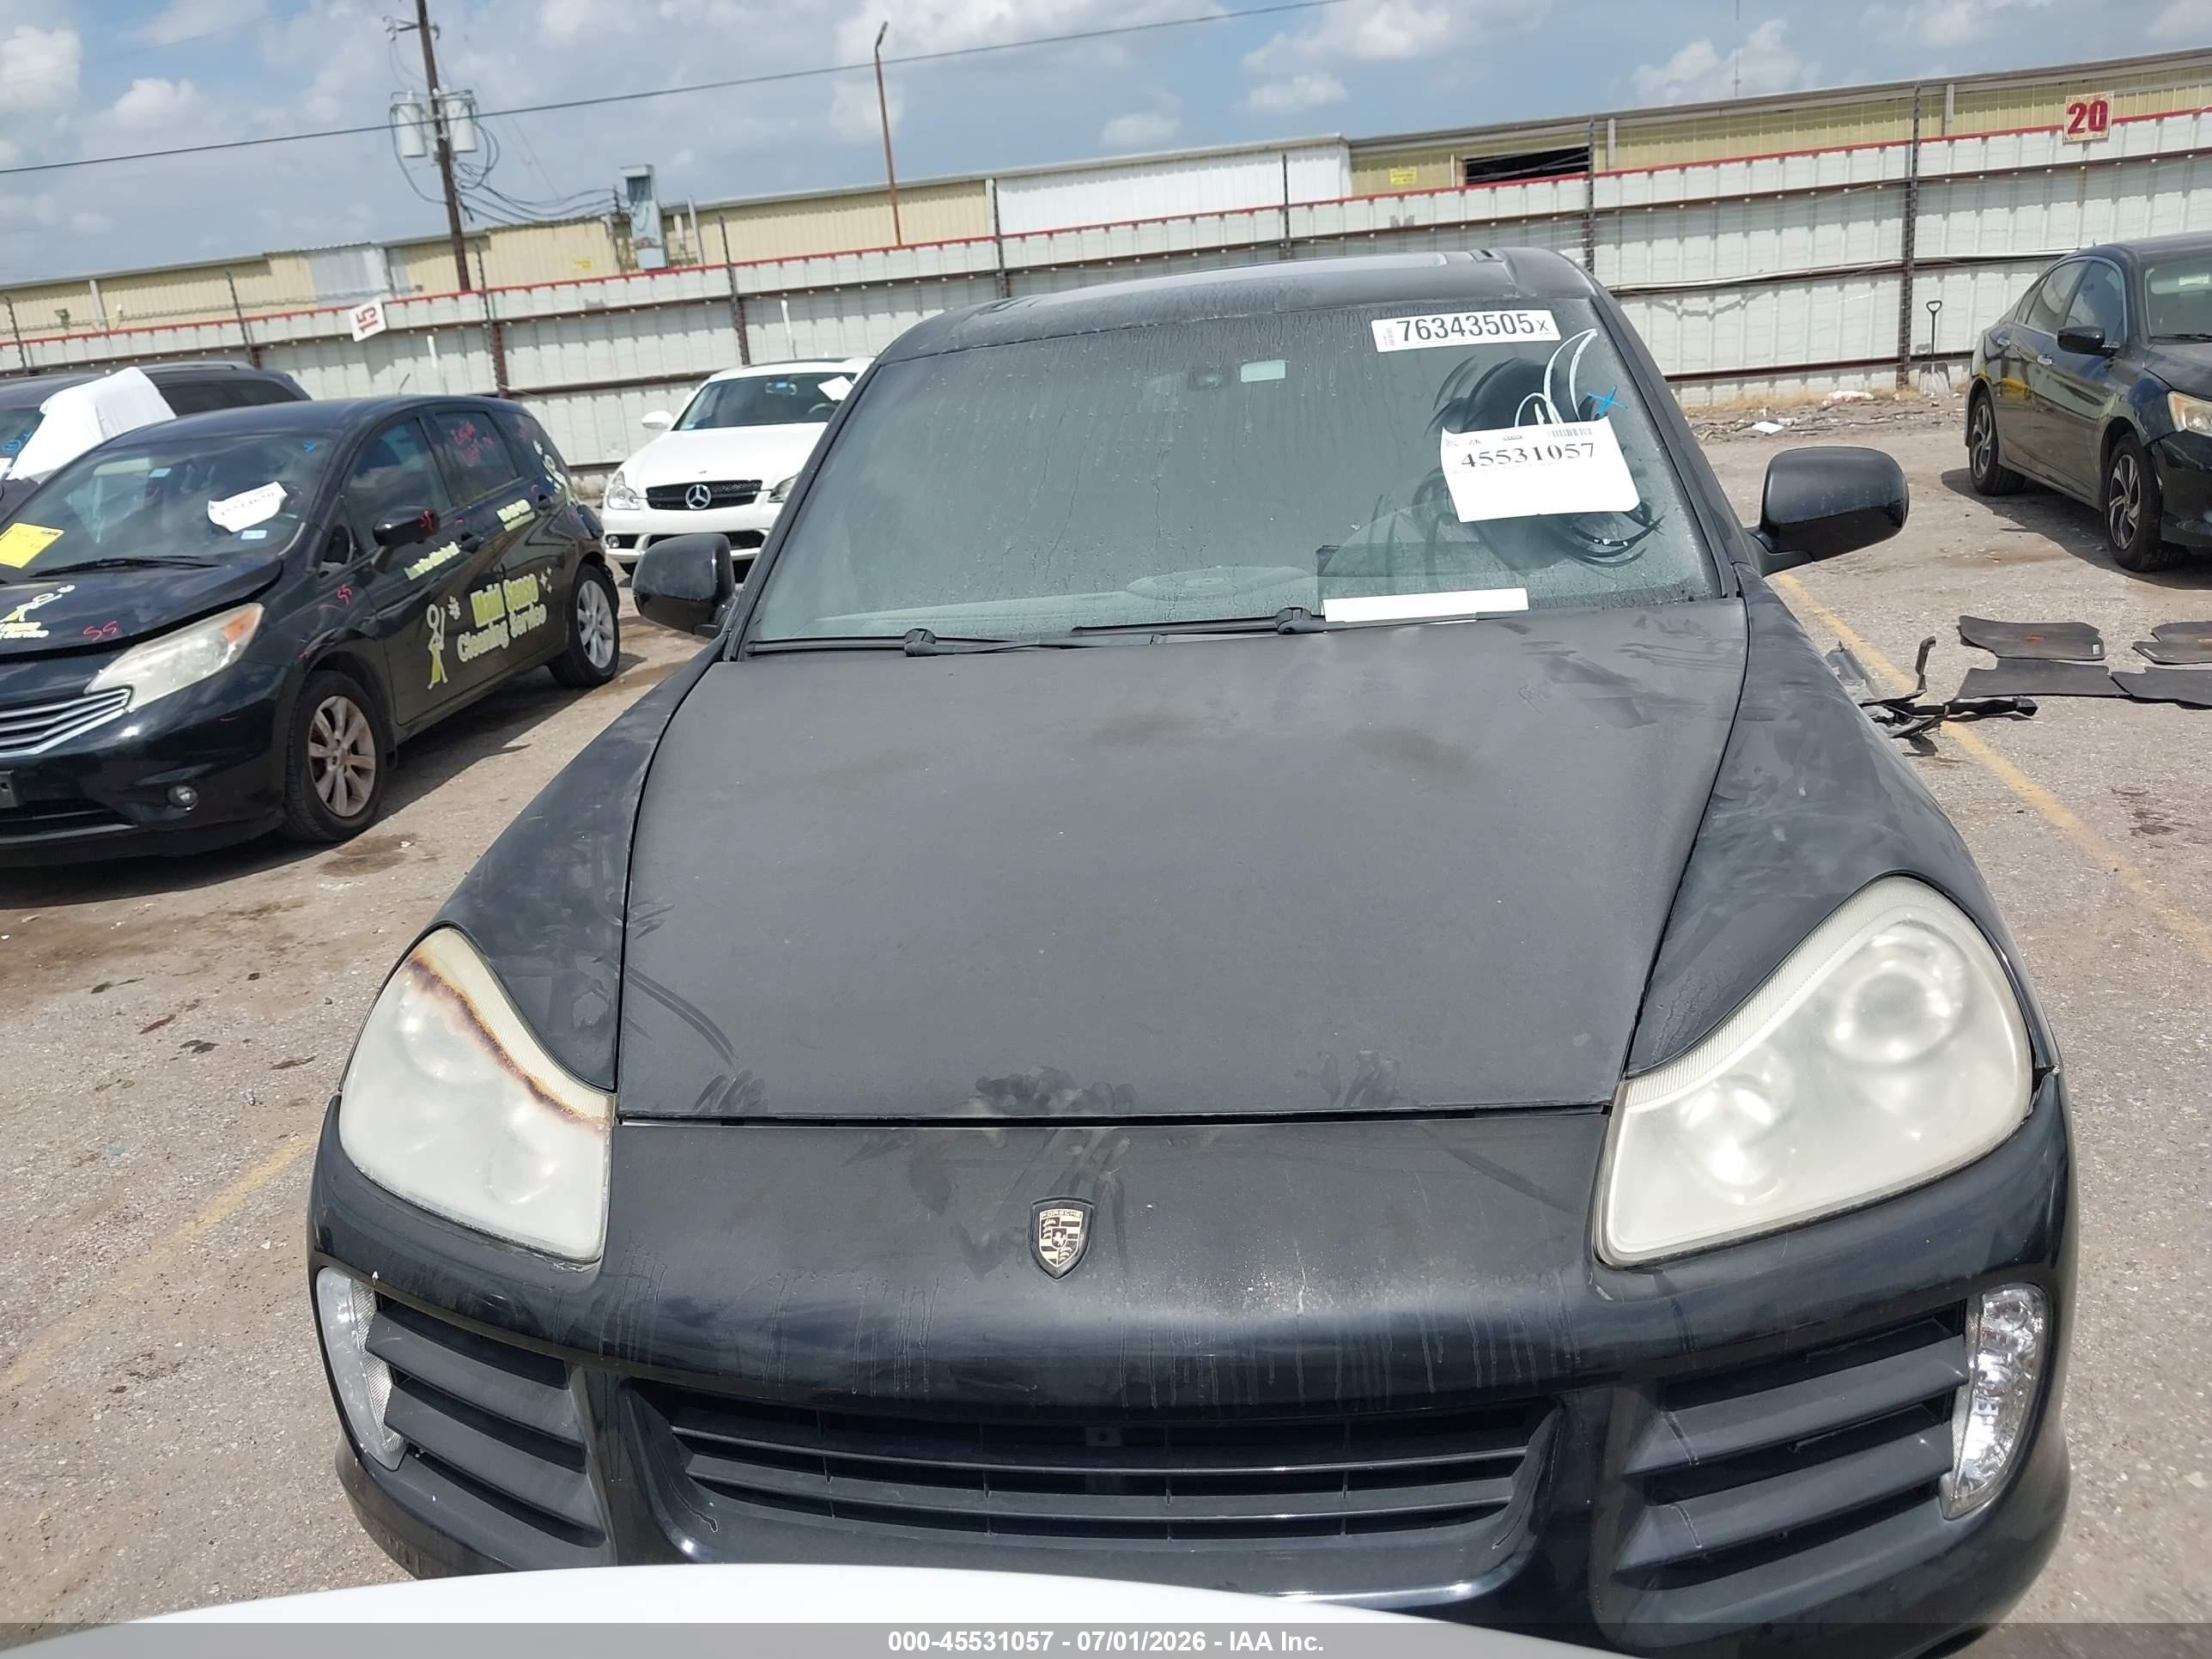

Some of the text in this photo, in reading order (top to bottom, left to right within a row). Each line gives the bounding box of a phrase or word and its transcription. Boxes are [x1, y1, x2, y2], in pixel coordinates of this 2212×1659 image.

[2067, 100, 2108, 134] 20
[356, 307, 379, 333] 15
[1461, 442, 1594, 467] 45531057
[458, 603, 547, 662] Cleaning Service
[1041, 1210, 1083, 1218] PORSCHE
